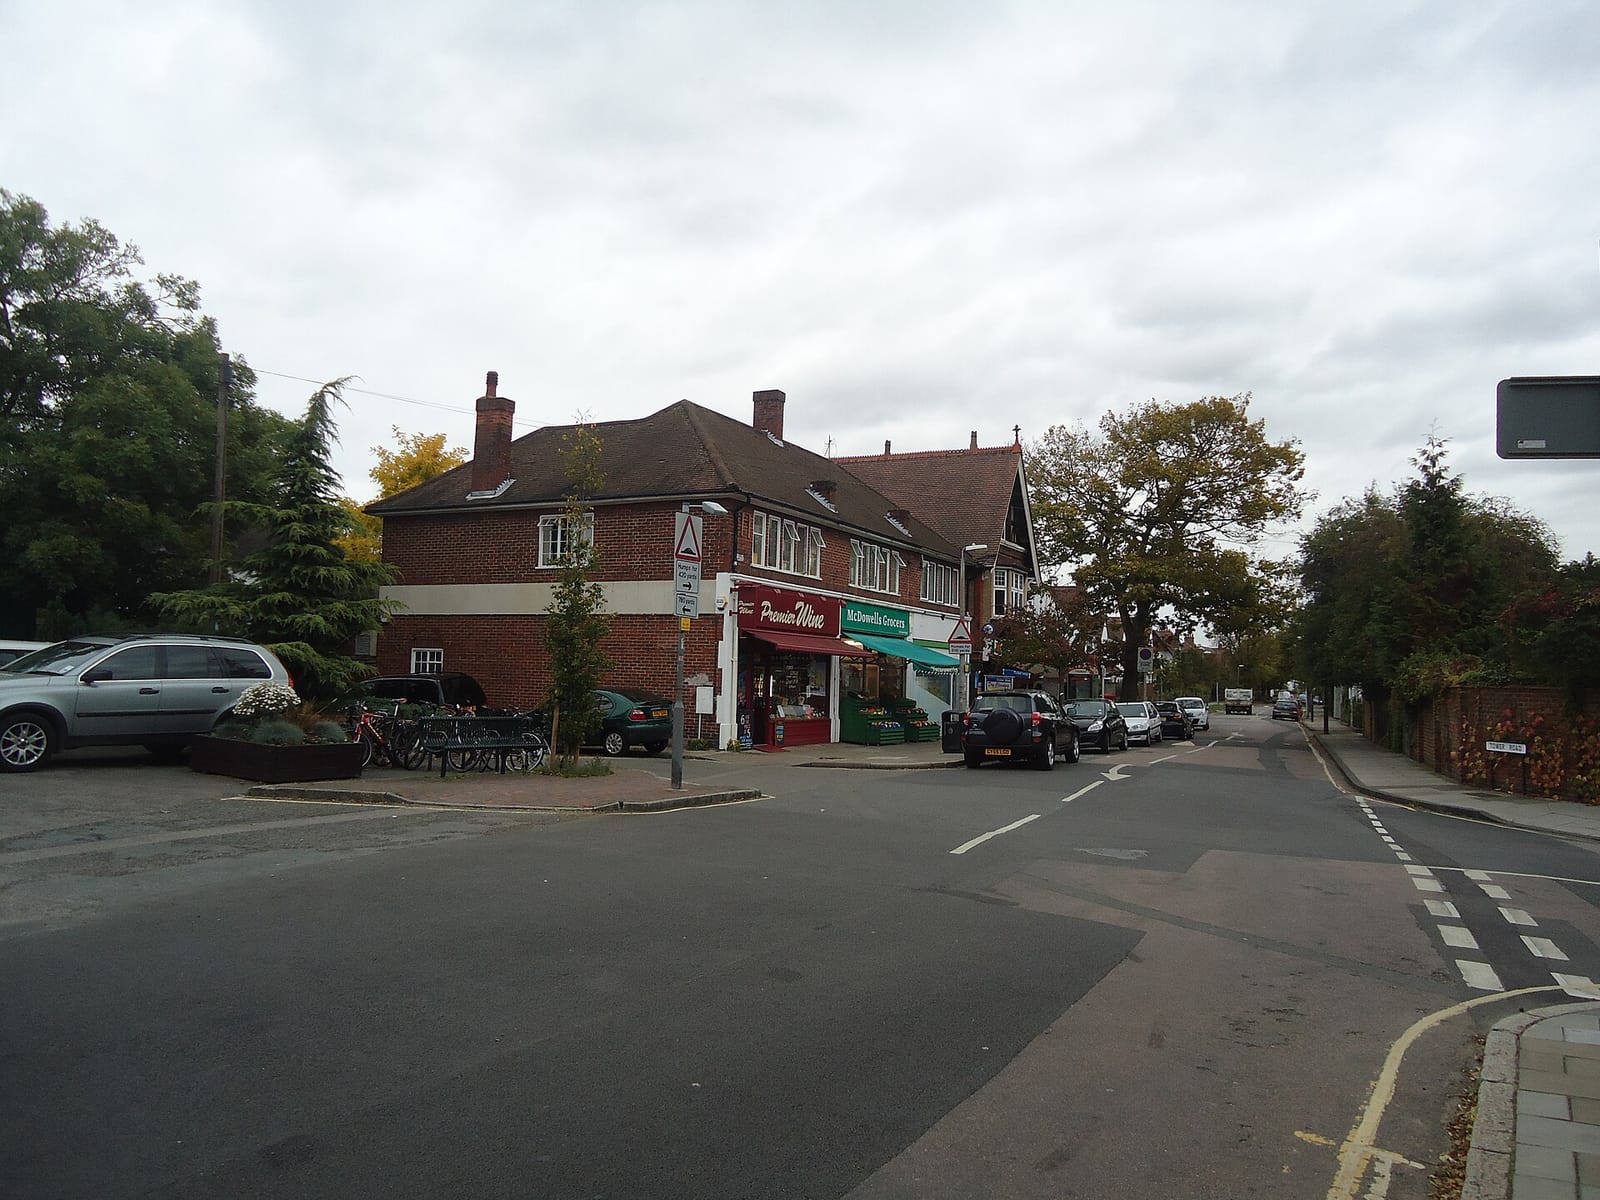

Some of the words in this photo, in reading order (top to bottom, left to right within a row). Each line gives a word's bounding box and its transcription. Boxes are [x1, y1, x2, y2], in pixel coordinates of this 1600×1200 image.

[760, 600, 796, 625] Premier
[795, 601, 825, 629] Wine
[846, 609, 882, 626] McDowells
[882, 615, 905, 629] Grocers
[1489, 742, 1505, 750] TOWER
[1508, 744, 1522, 752] ROAD
